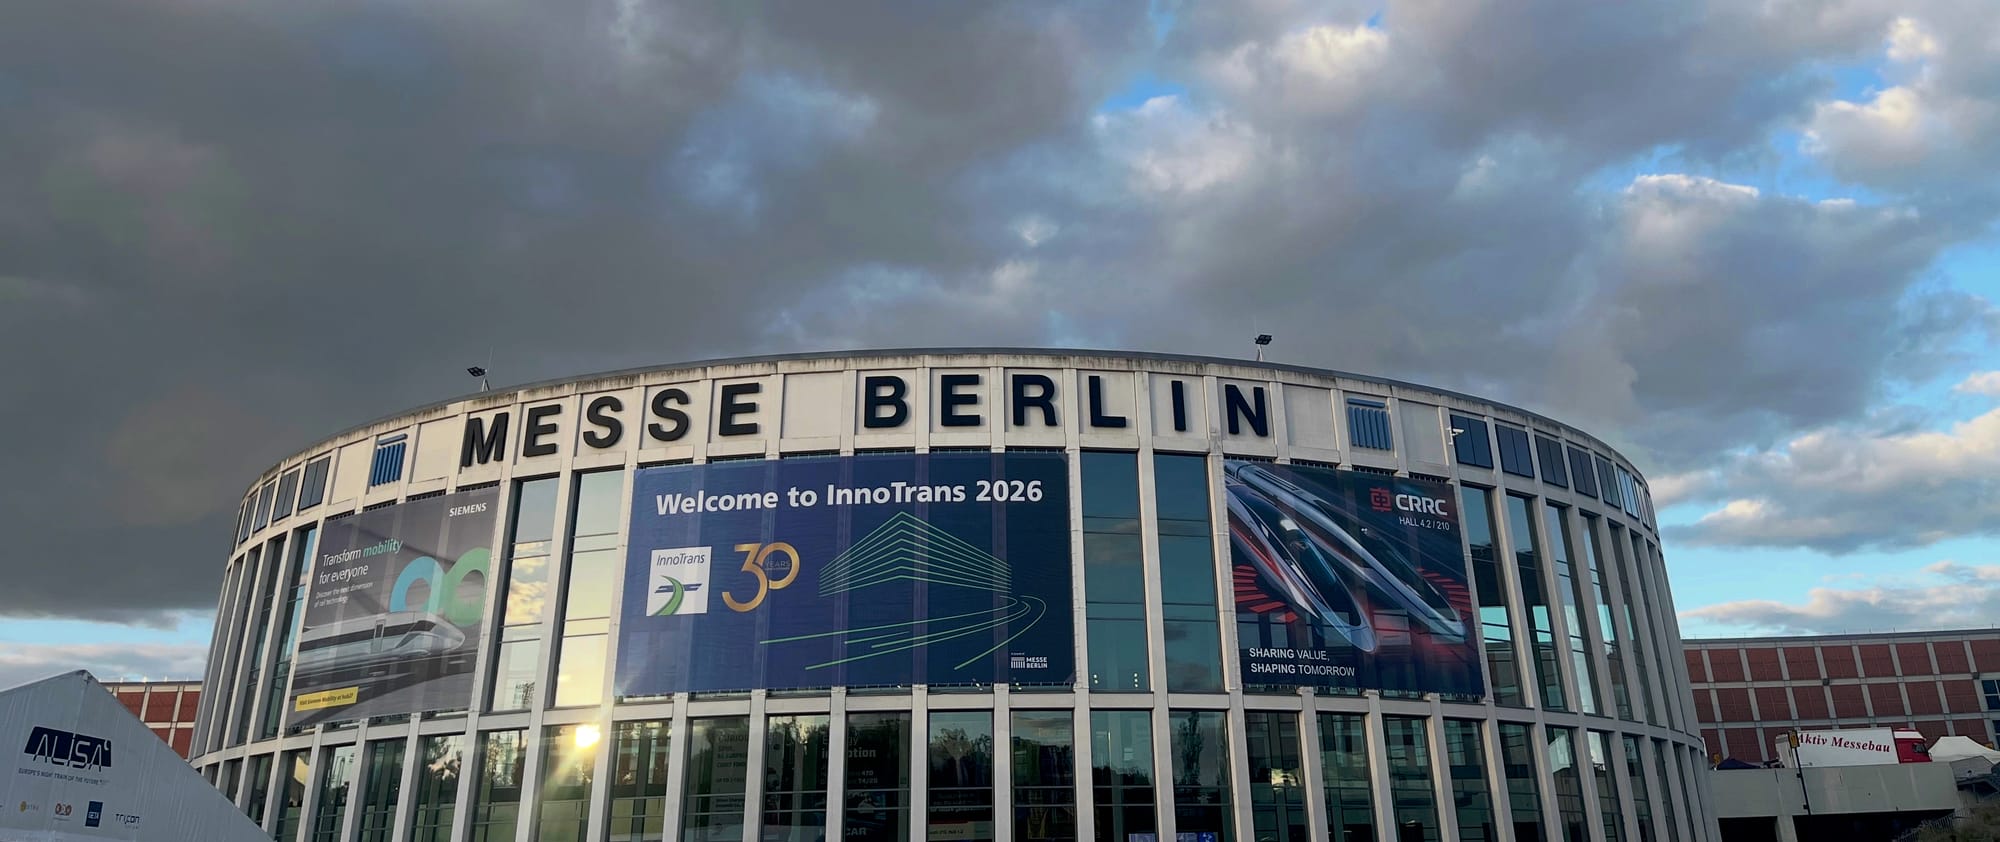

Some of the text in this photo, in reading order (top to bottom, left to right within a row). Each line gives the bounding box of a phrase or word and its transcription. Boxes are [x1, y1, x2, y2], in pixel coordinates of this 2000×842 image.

[461, 374, 1269, 467] MESSE BERLIN
[656, 480, 1043, 515] Welcome to InnoTrans 2026
[1395, 494, 1448, 516] CRRC
[449, 502, 488, 517] SIEMENS
[1398, 516, 1420, 527] HALL
[1437, 521, 1450, 531] 210
[323, 538, 404, 567] Transform mobility
[656, 553, 706, 566] InnoTrans
[765, 560, 791, 568] YEARS
[318, 565, 369, 585] for everyone
[722, 542, 800, 612] 30
[1249, 647, 1330, 661] SHARING VALUE,
[1250, 663, 1355, 677] SHAPING TOMORROW
[33, 733, 102, 772] ALISA
[1798, 733, 1890, 753] Aktiv Messebau
